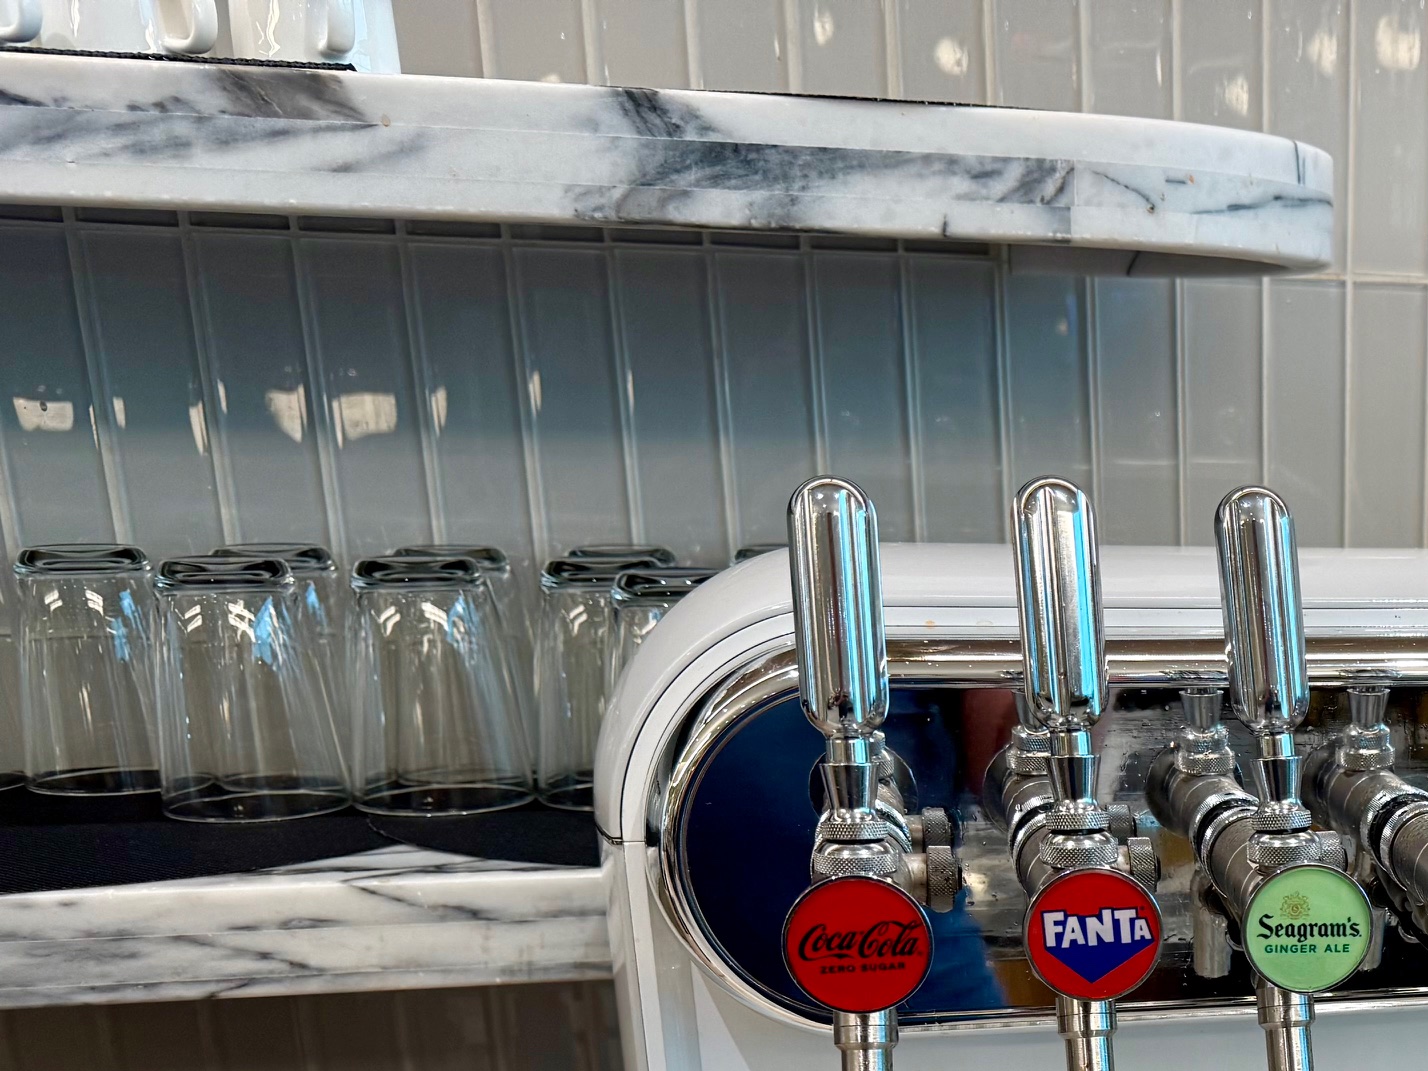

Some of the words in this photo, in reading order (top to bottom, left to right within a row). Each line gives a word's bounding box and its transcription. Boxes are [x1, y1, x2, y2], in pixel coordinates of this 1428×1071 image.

[1264, 944, 1317, 954] GINGER
[1324, 943, 1350, 953] ALE
[820, 962, 856, 975] ZERO
[860, 961, 906, 974] SUGAR
